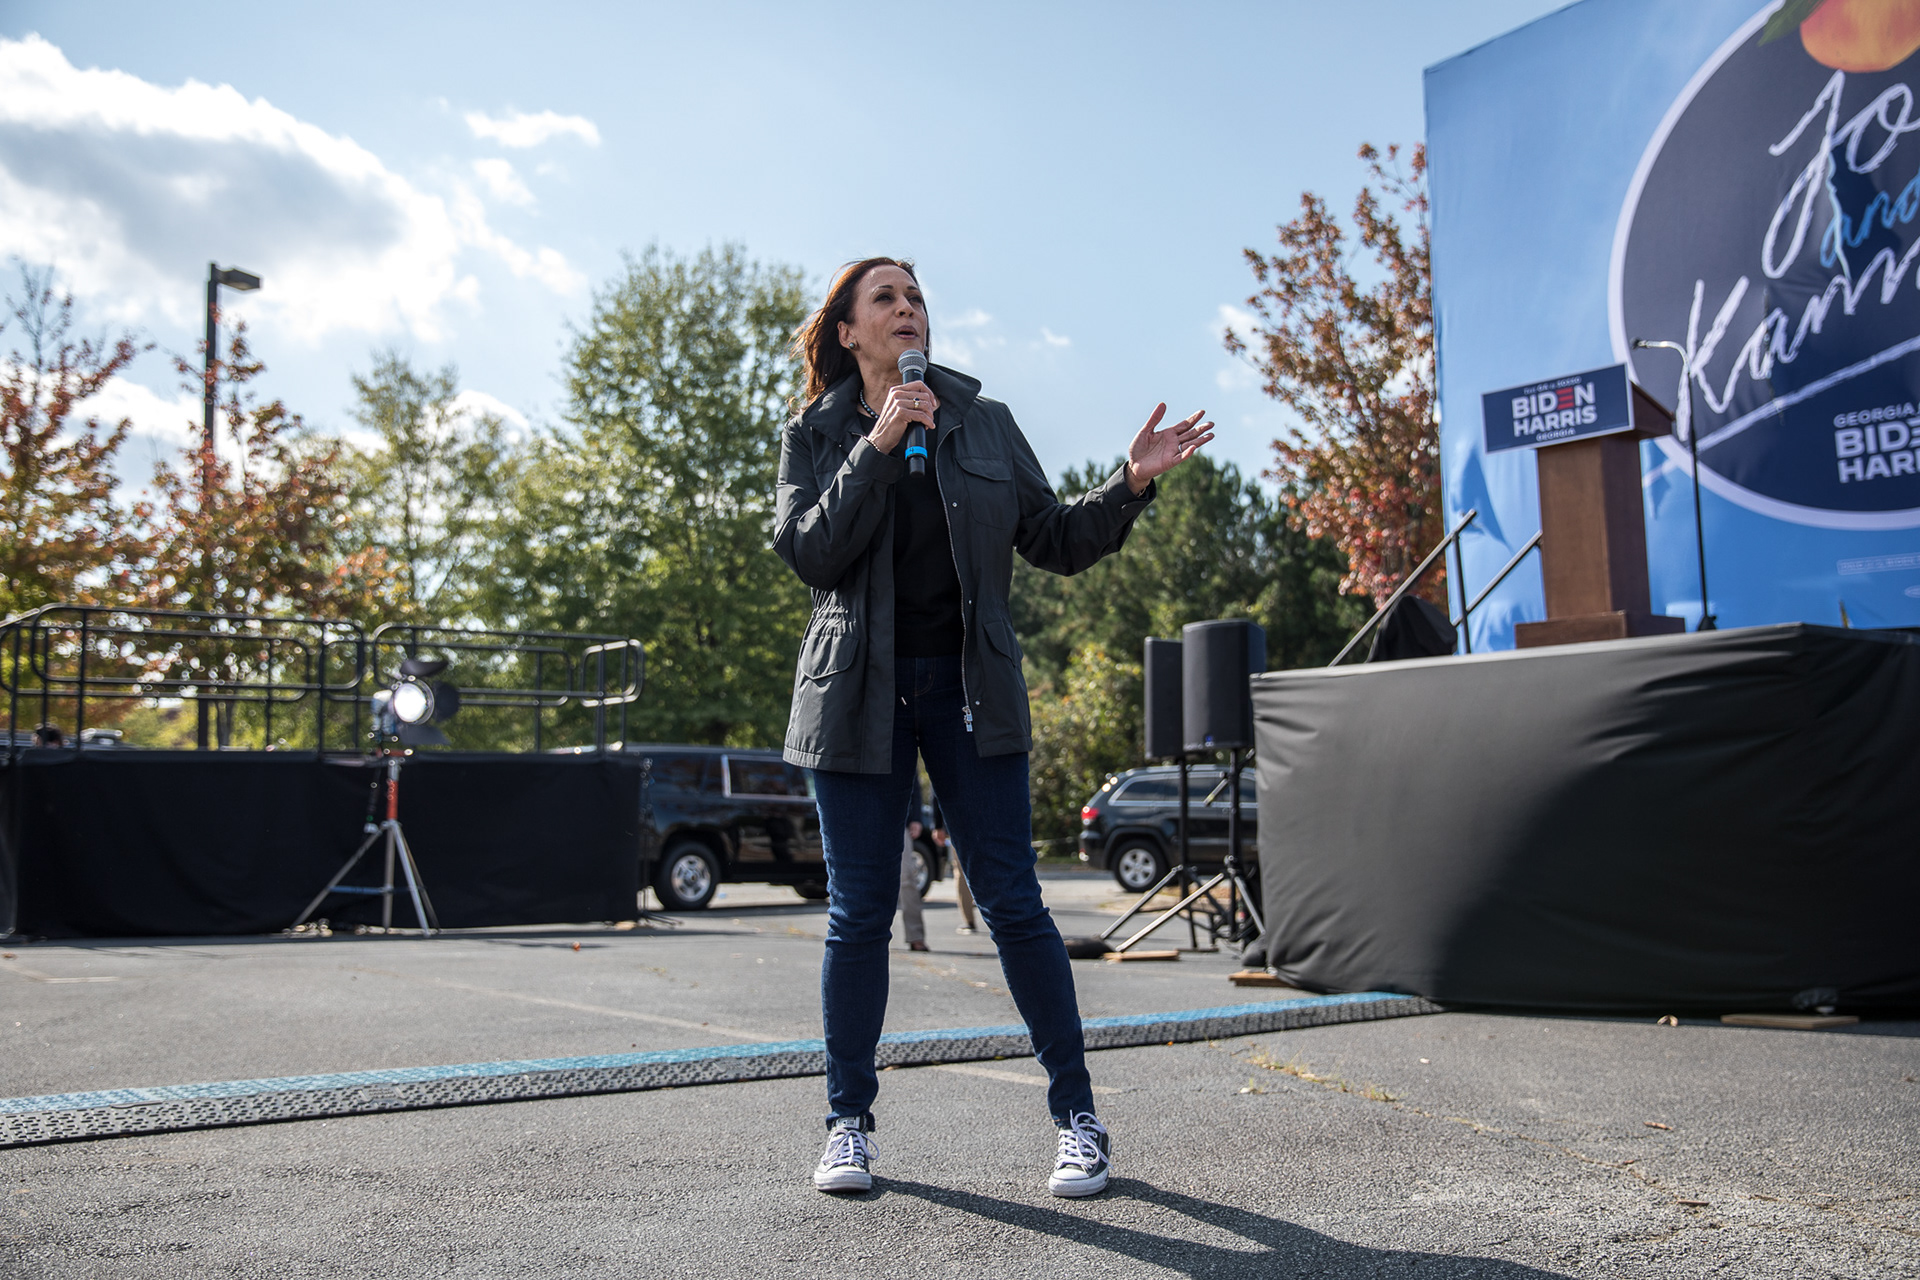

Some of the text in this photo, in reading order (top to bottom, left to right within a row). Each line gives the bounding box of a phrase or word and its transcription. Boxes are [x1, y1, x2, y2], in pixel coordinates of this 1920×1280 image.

[1676, 238, 1920, 441] Kam
[1511, 382, 1597, 419] BIDEN
[1833, 402, 1916, 428] GEORGIA
[1513, 405, 1598, 437] HARRIS
[1536, 427, 1576, 441] GEORGIA
[1837, 448, 1920, 484] HAR
